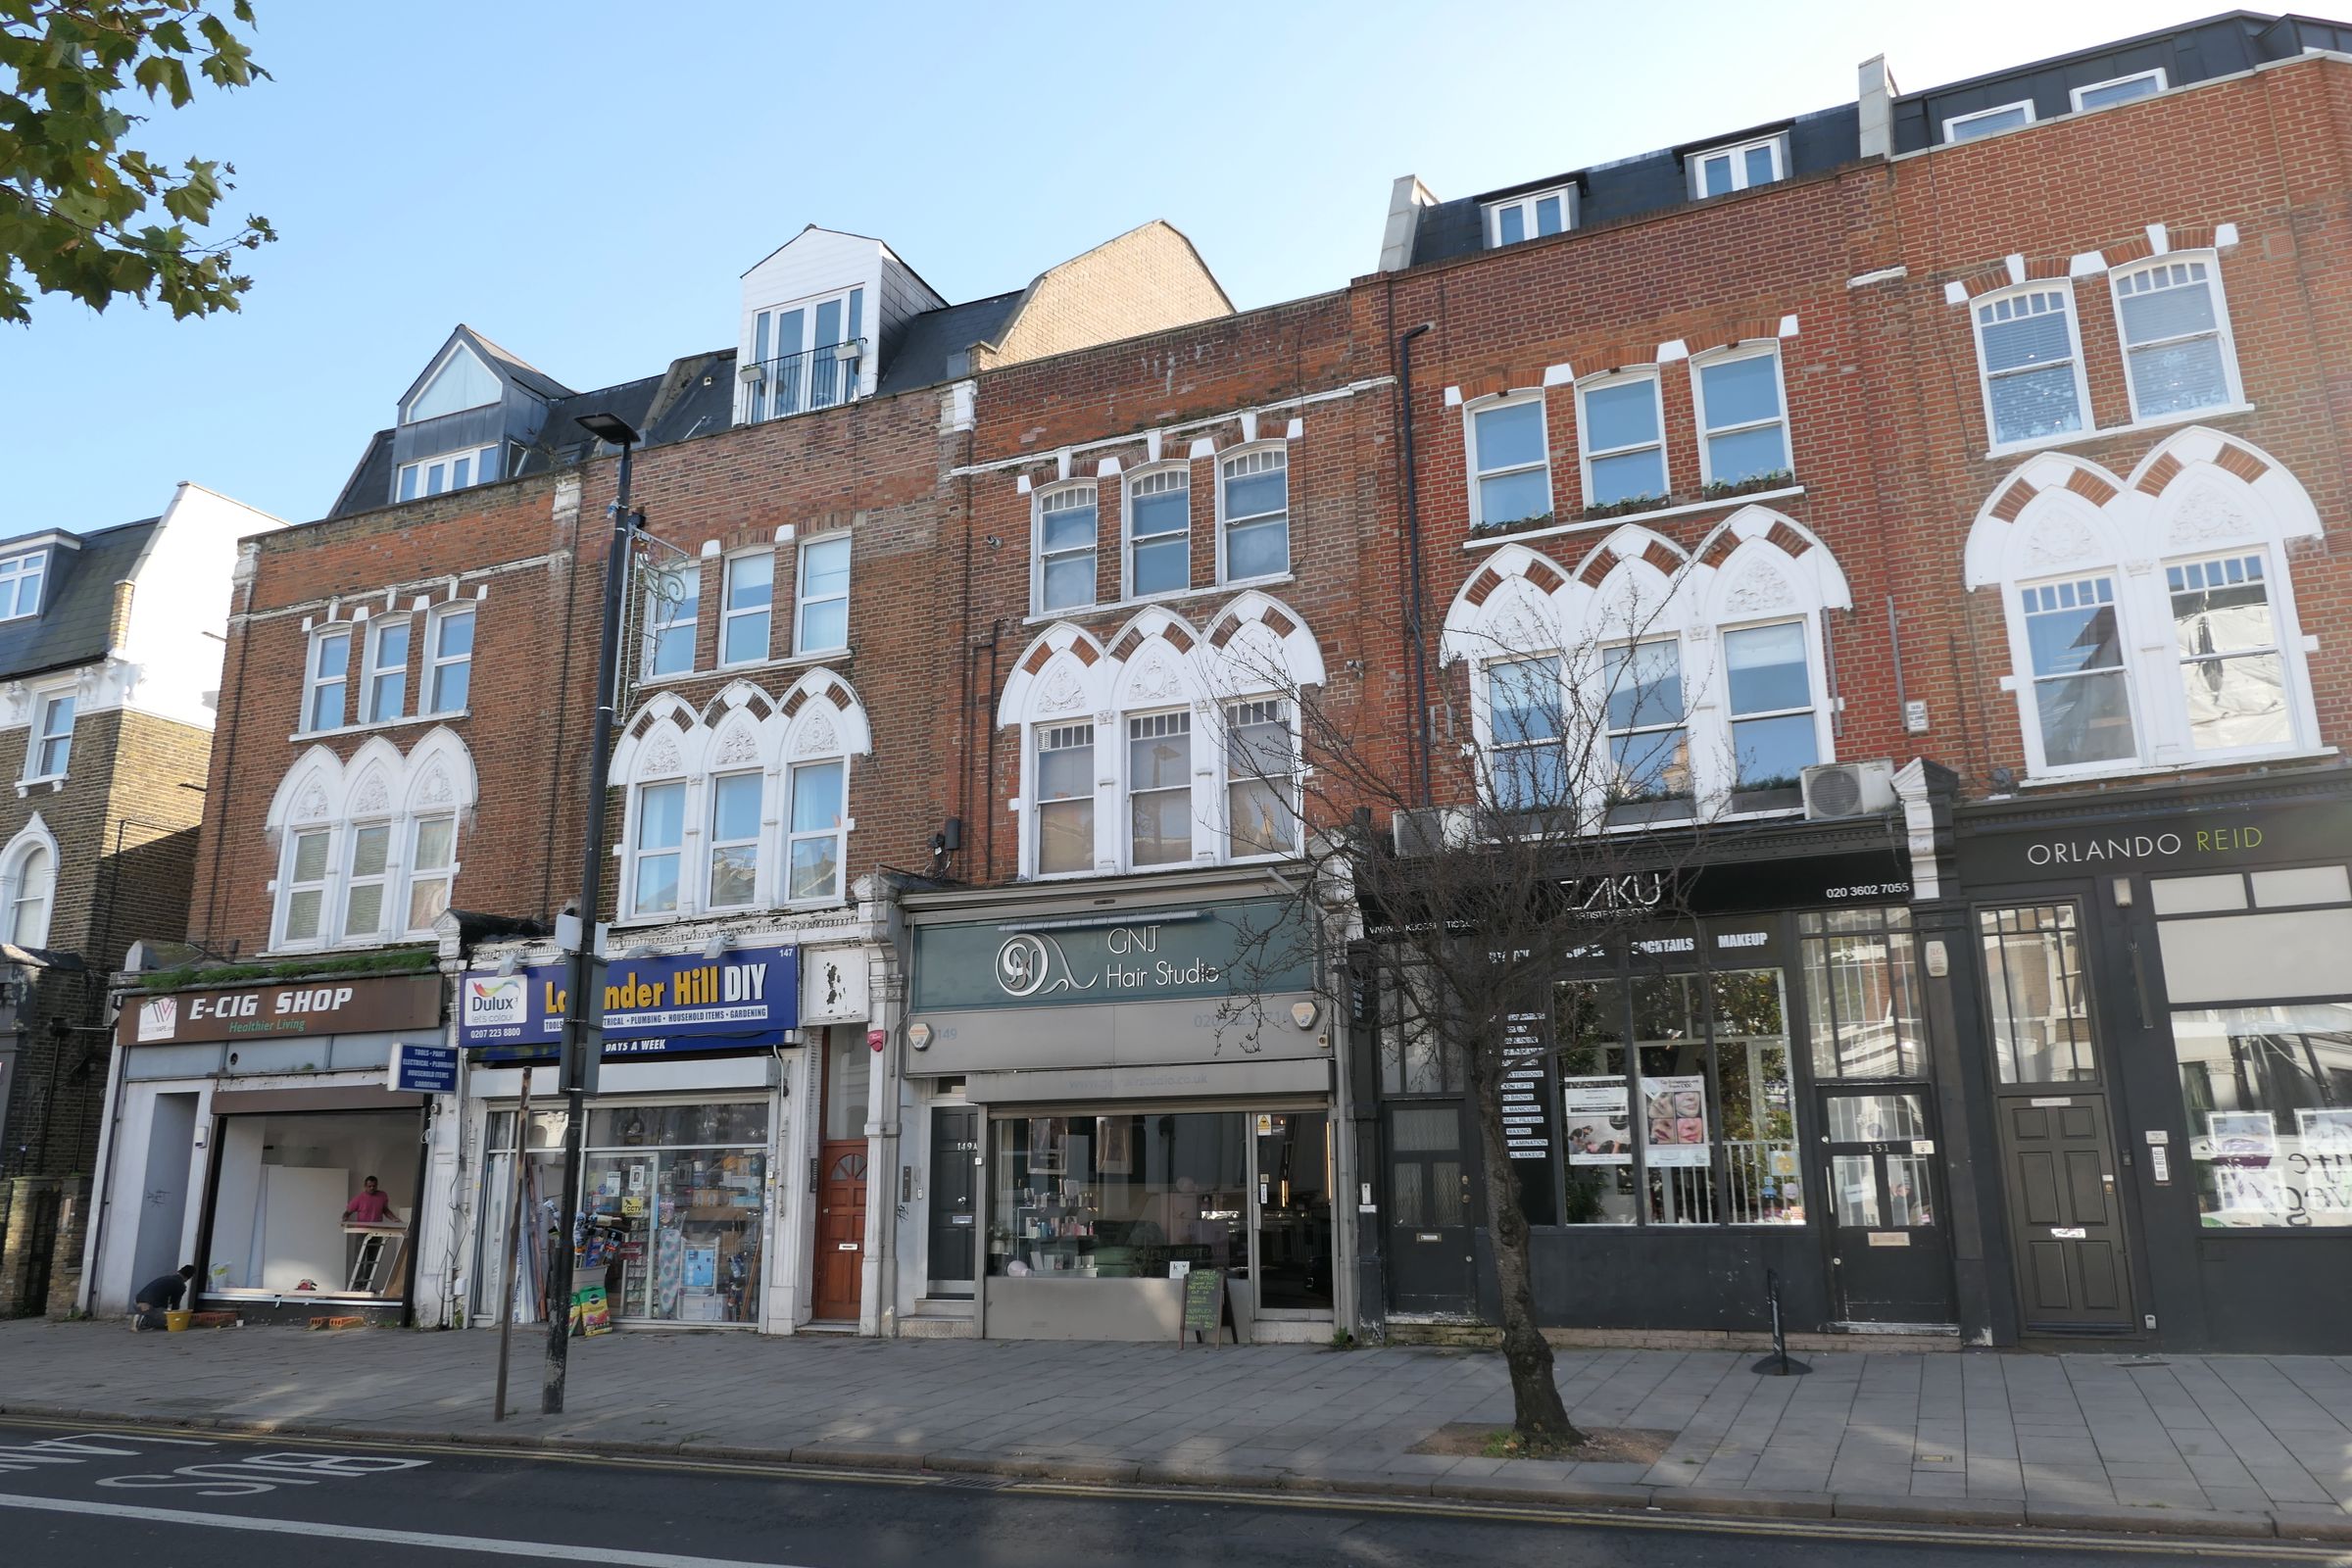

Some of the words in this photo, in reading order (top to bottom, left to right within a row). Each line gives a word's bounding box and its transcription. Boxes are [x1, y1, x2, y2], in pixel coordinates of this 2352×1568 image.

[2028, 833, 2181, 864] ORLANDO
[2196, 827, 2263, 852] REID
[1826, 888, 1847, 898] 020
[1850, 885, 1879, 897] 3602
[1880, 882, 1909, 894] 7055
[1107, 925, 1161, 954] GNJ
[1630, 938, 1694, 955] COCKTAILS
[1718, 932, 1768, 948] MAKEUP
[779, 949, 794, 957] 147
[1106, 962, 1148, 989] Hair
[1155, 957, 1220, 986] Studio
[546, 971, 665, 1013] Lander
[674, 966, 719, 1005] Hill
[724, 963, 767, 1003] DIY
[189, 994, 259, 1020] E-CIG
[274, 988, 353, 1014] SHOP
[472, 995, 514, 1011] Dulux
[228, 1020, 274, 1033] Healthier
[276, 1018, 306, 1032] Living
[545, 1020, 563, 1030] TOOLS
[604, 1017, 624, 1026] TRICAL
[630, 1015, 662, 1025] PLUMBING
[668, 1011, 705, 1022] HOUSEHOLD
[706, 1010, 724, 1020] ITEMS
[730, 1007, 766, 1018] GARDENING
[470, 1029, 487, 1039] 0207
[489, 1028, 502, 1038] 223
[503, 1027, 520, 1037] 8800
[605, 1041, 628, 1052] DAYS
[631, 1041, 638, 1051] A
[640, 1039, 666, 1050] WEEK
[956, 1142, 978, 1152] 149A
[1868, 1144, 1890, 1152] 151
[0, 1434, 220, 1472] LAN
